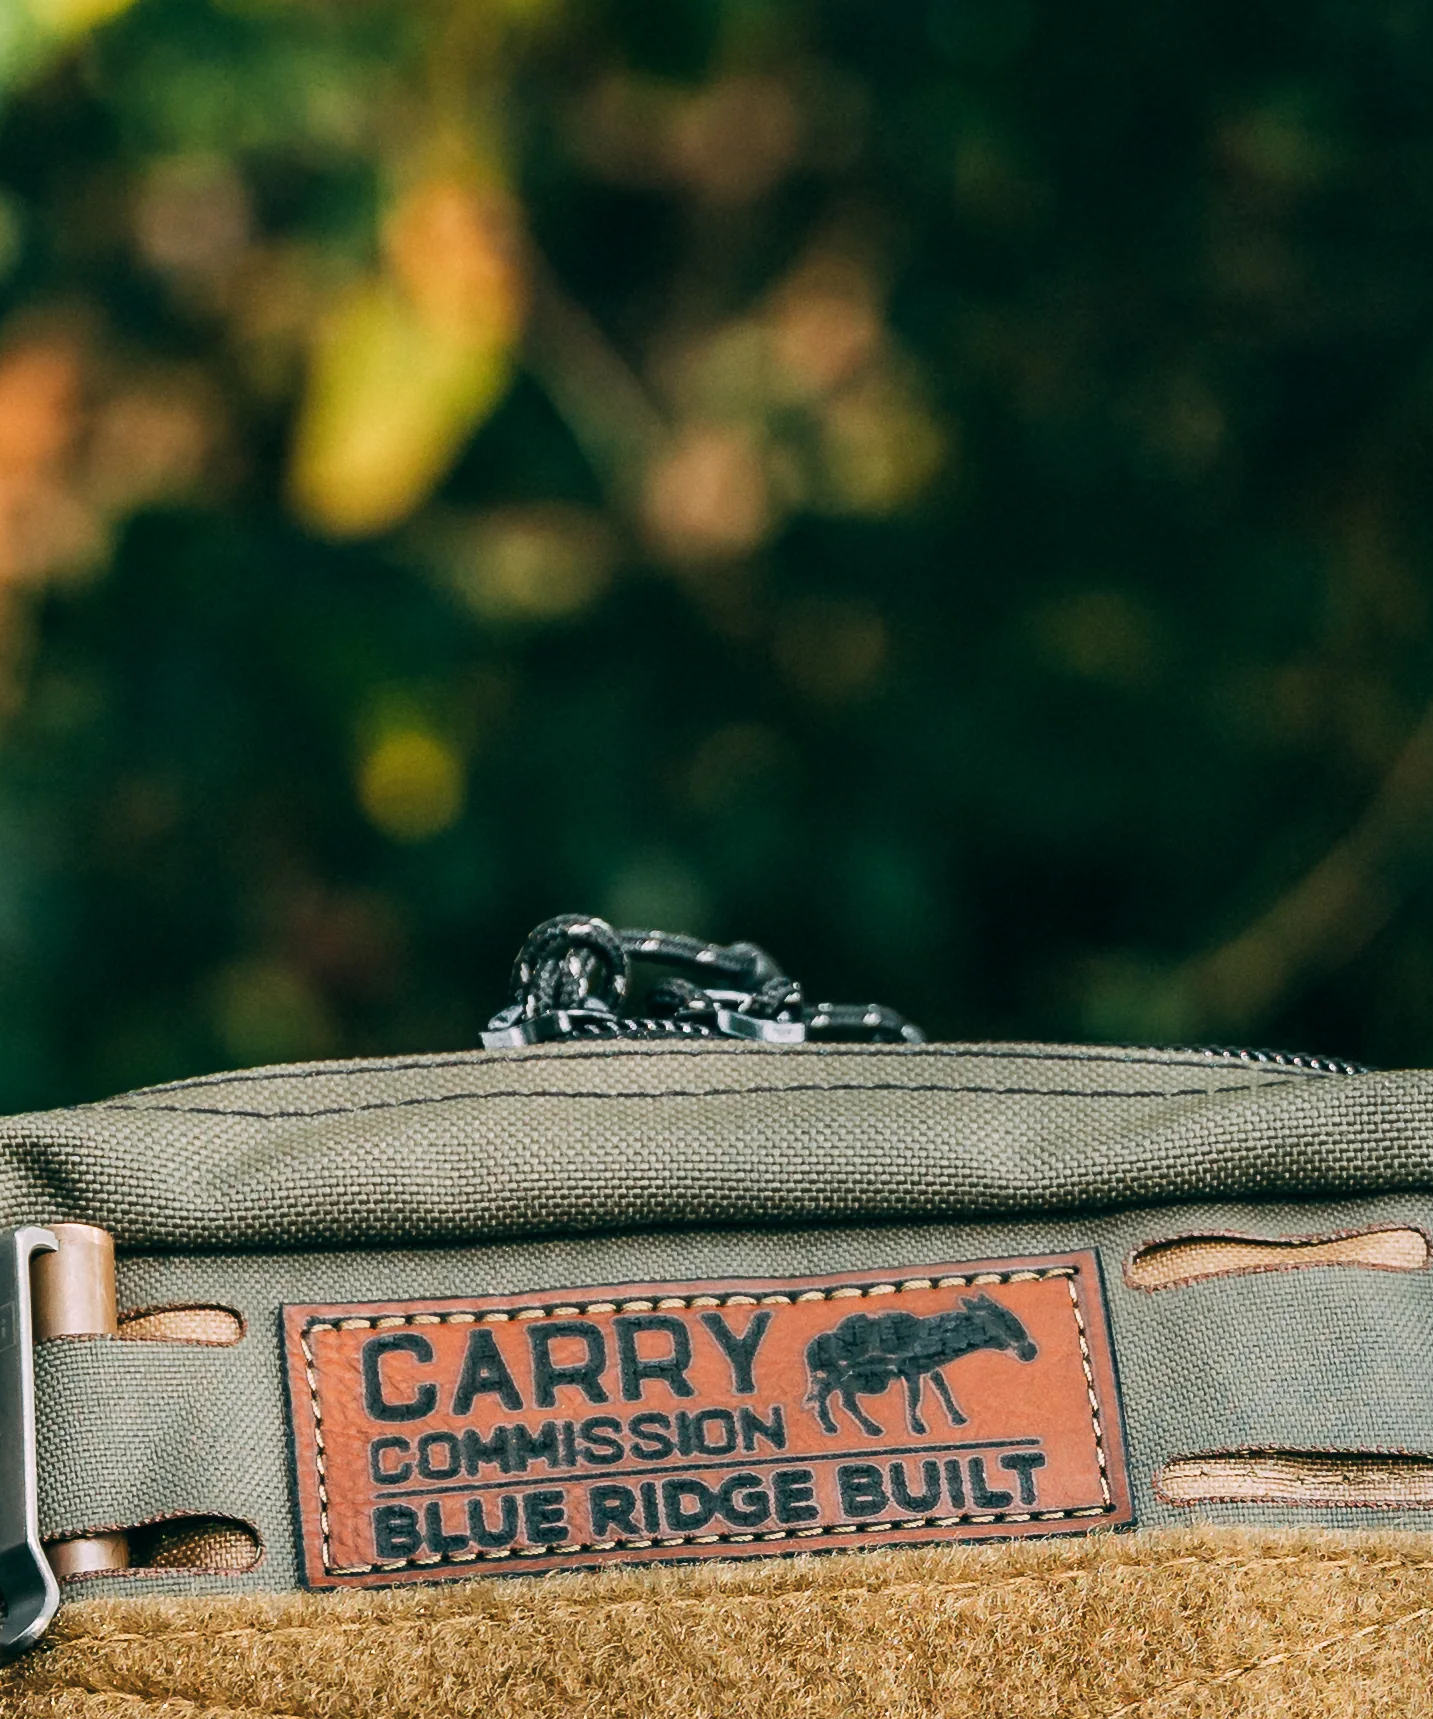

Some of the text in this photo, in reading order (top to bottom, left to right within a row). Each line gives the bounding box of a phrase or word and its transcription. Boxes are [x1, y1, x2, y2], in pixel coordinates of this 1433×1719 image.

[363, 1311, 772, 1422] CARRY
[370, 1406, 787, 1484] COMMISSION
[374, 1452, 1046, 1559] BLUE RIDGE BUILT
